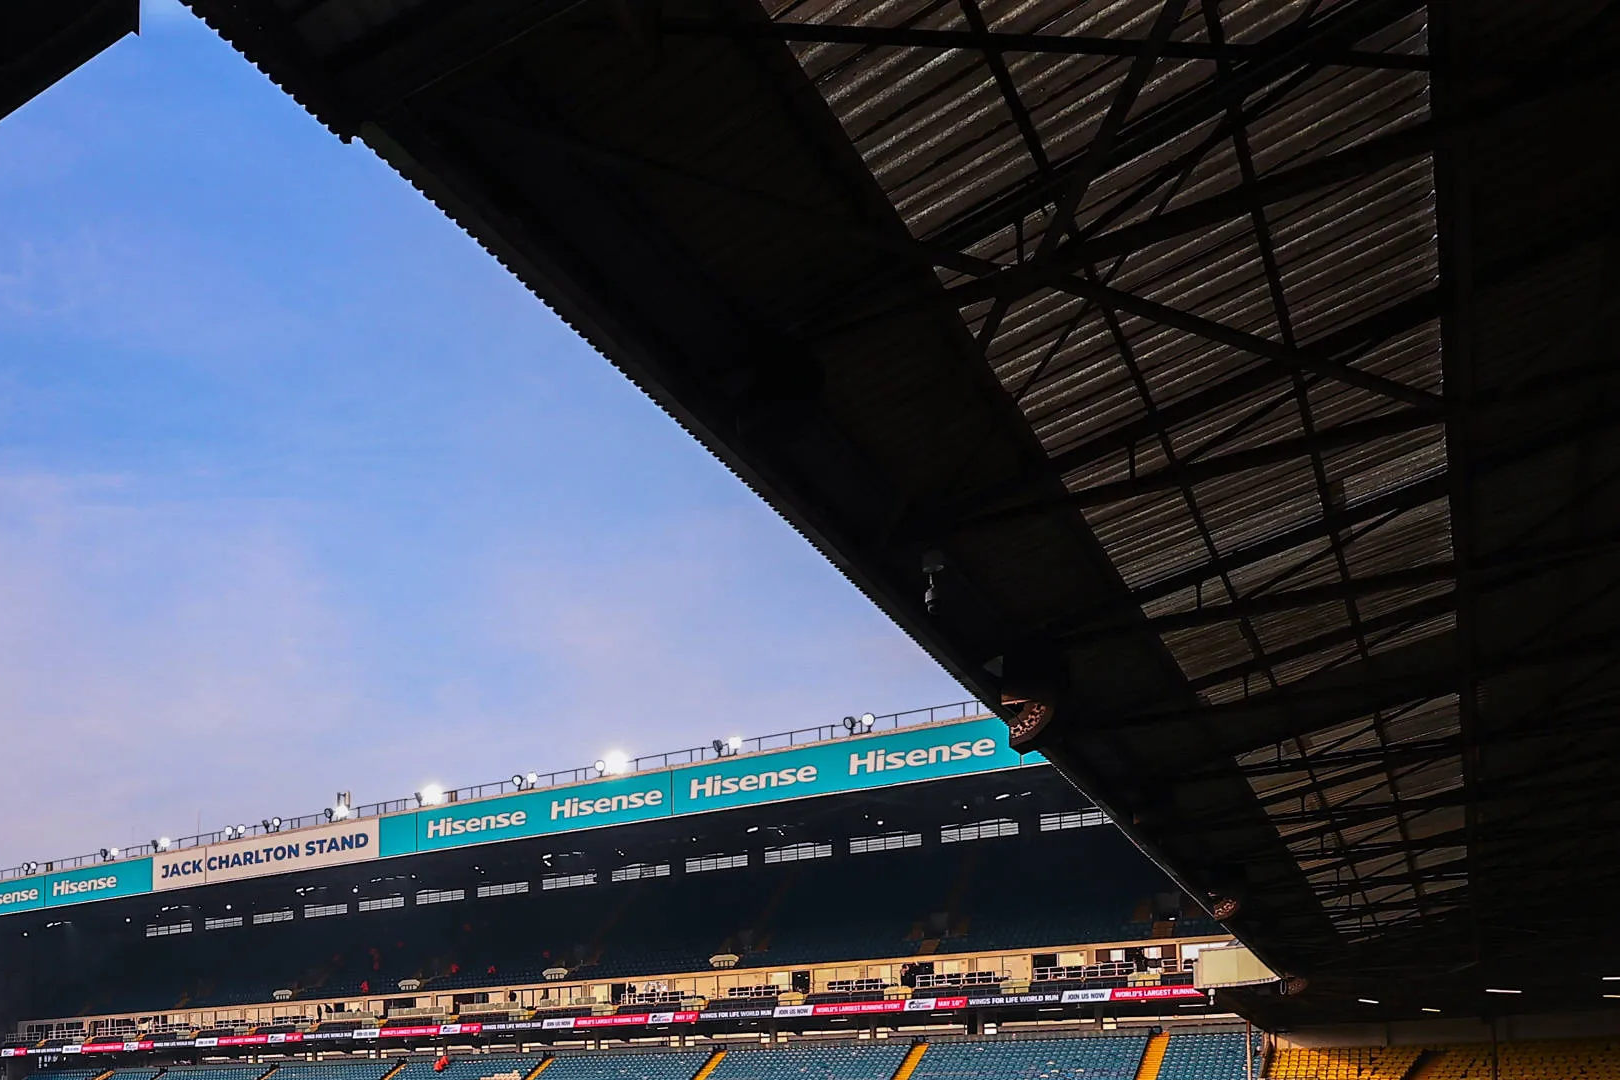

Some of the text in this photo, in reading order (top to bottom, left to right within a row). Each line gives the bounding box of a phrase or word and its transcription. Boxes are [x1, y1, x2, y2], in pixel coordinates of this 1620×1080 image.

[848, 736, 995, 776] Hisense
[689, 763, 817, 799] Hisense
[551, 788, 662, 820] Hisense
[428, 809, 526, 840] Hisense
[162, 832, 369, 879] JACK CHARLTON STAND
[52, 874, 117, 897] Hisense
